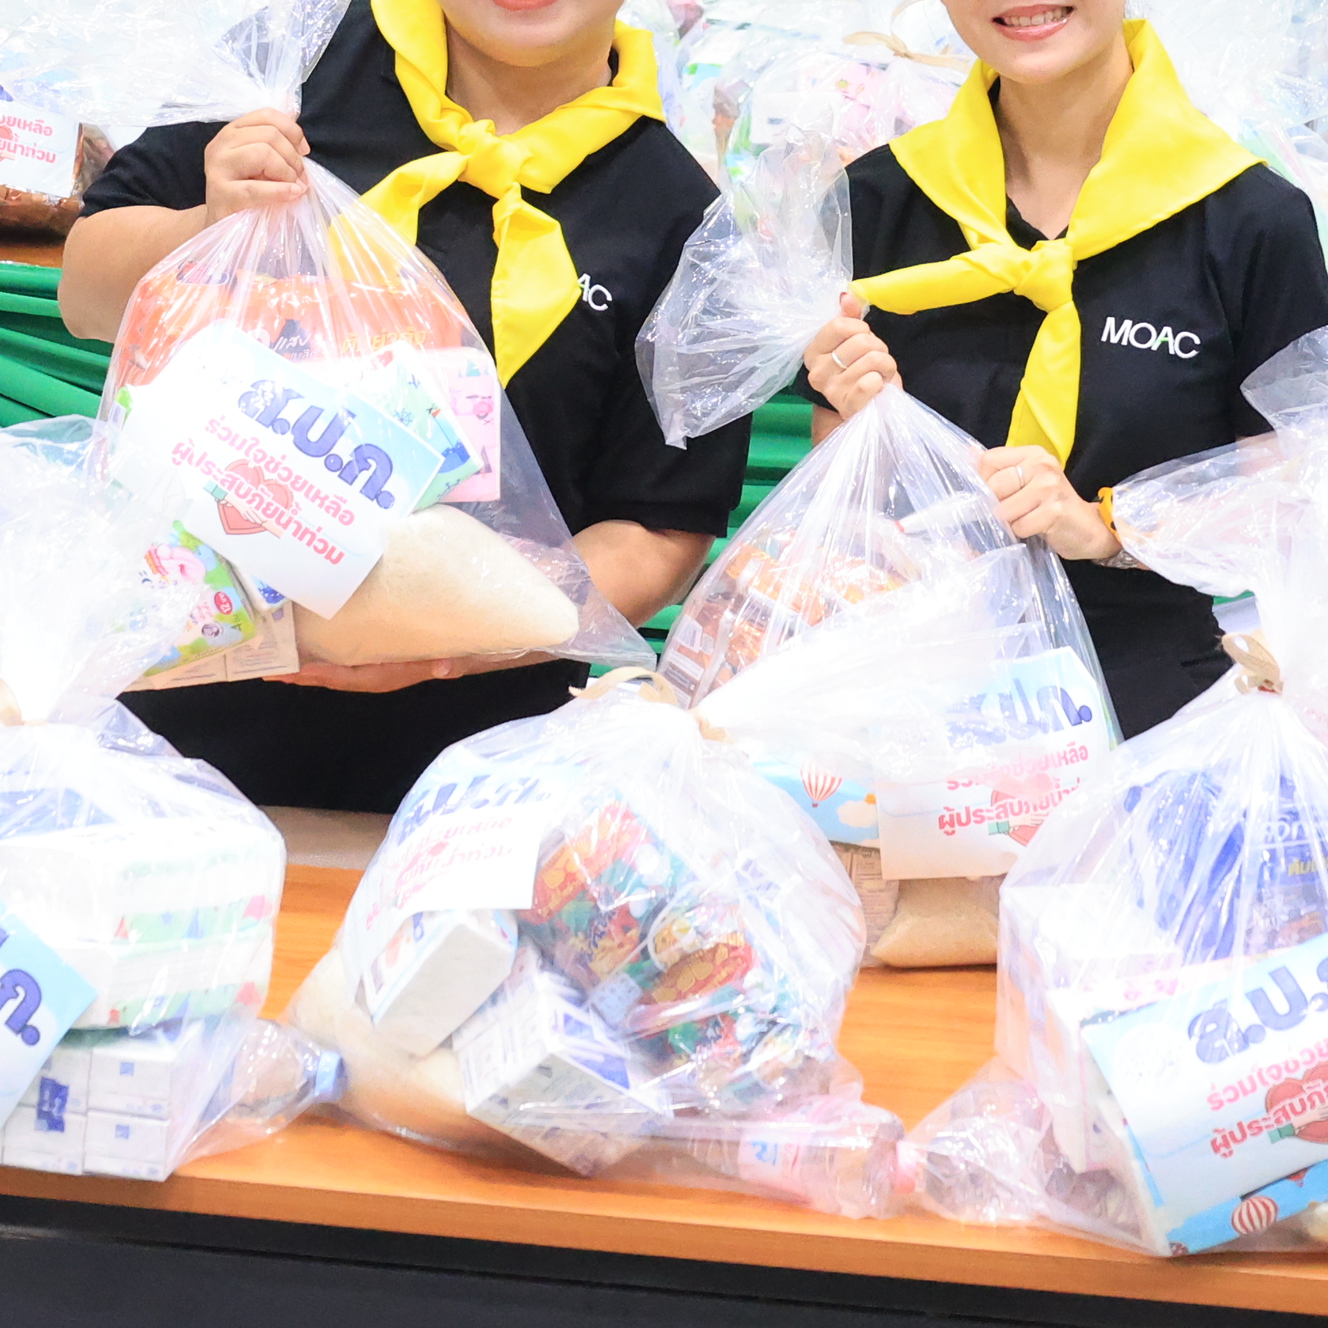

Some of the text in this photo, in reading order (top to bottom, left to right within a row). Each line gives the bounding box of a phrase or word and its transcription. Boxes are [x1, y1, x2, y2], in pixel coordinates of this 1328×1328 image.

[576, 272, 613, 312] AC
[1101, 317, 1201, 359] MOAC
[205, 415, 356, 527] ร่วมใจช่วยเหลือ
[238, 380, 396, 510] ส.ป.ก.
[172, 439, 345, 566] ผู้ประสบภัยน้ำท่วม
